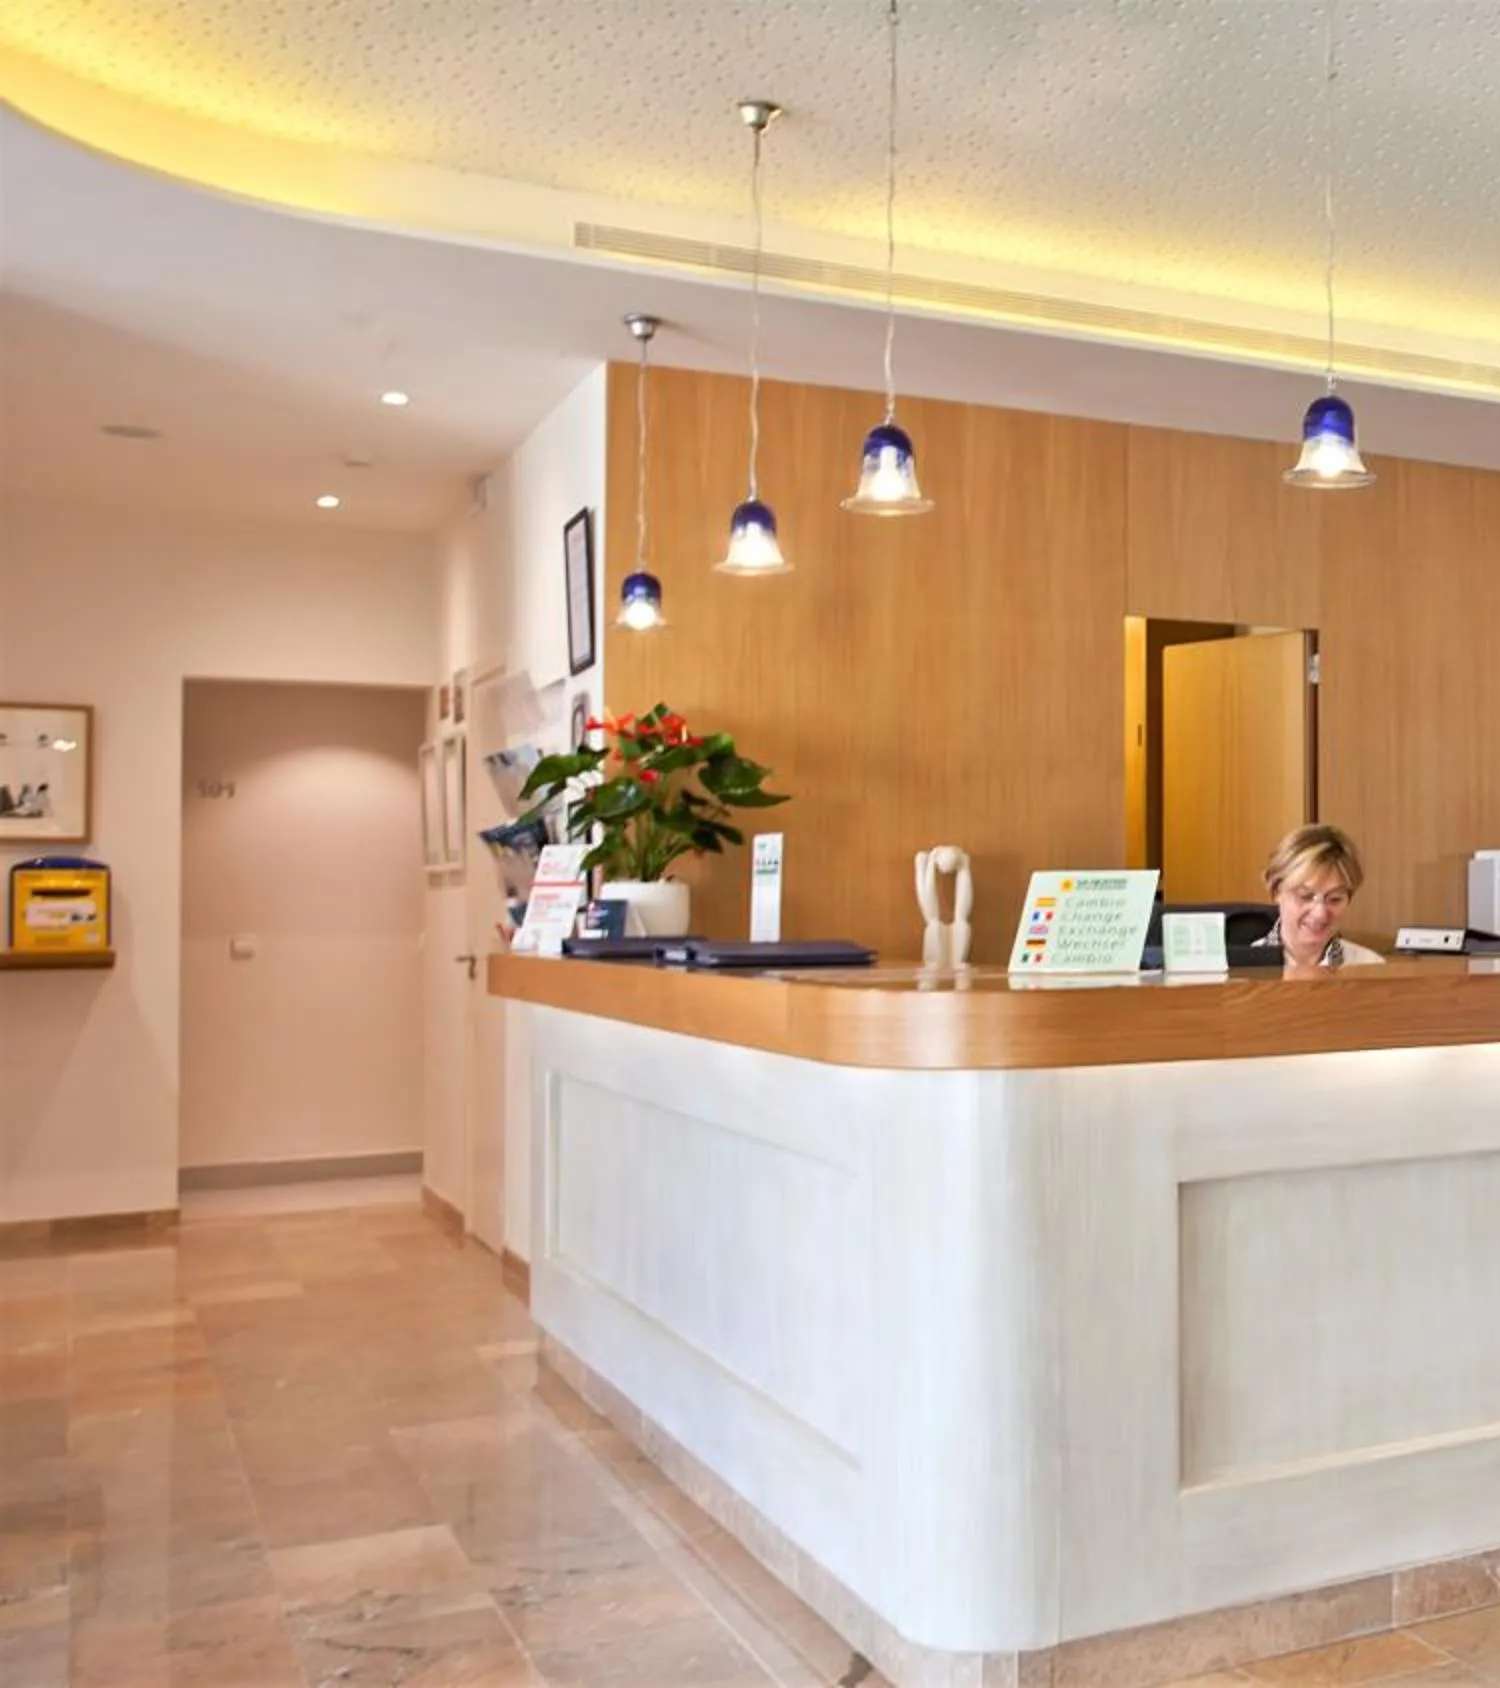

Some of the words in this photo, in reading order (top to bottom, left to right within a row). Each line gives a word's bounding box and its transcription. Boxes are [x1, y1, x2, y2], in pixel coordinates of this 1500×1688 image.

[1065, 897, 1126, 908] Cambio
[1061, 910, 1123, 924] Change
[1058, 925, 1137, 939] Exchange
[1051, 953, 1113, 964] Cambio
